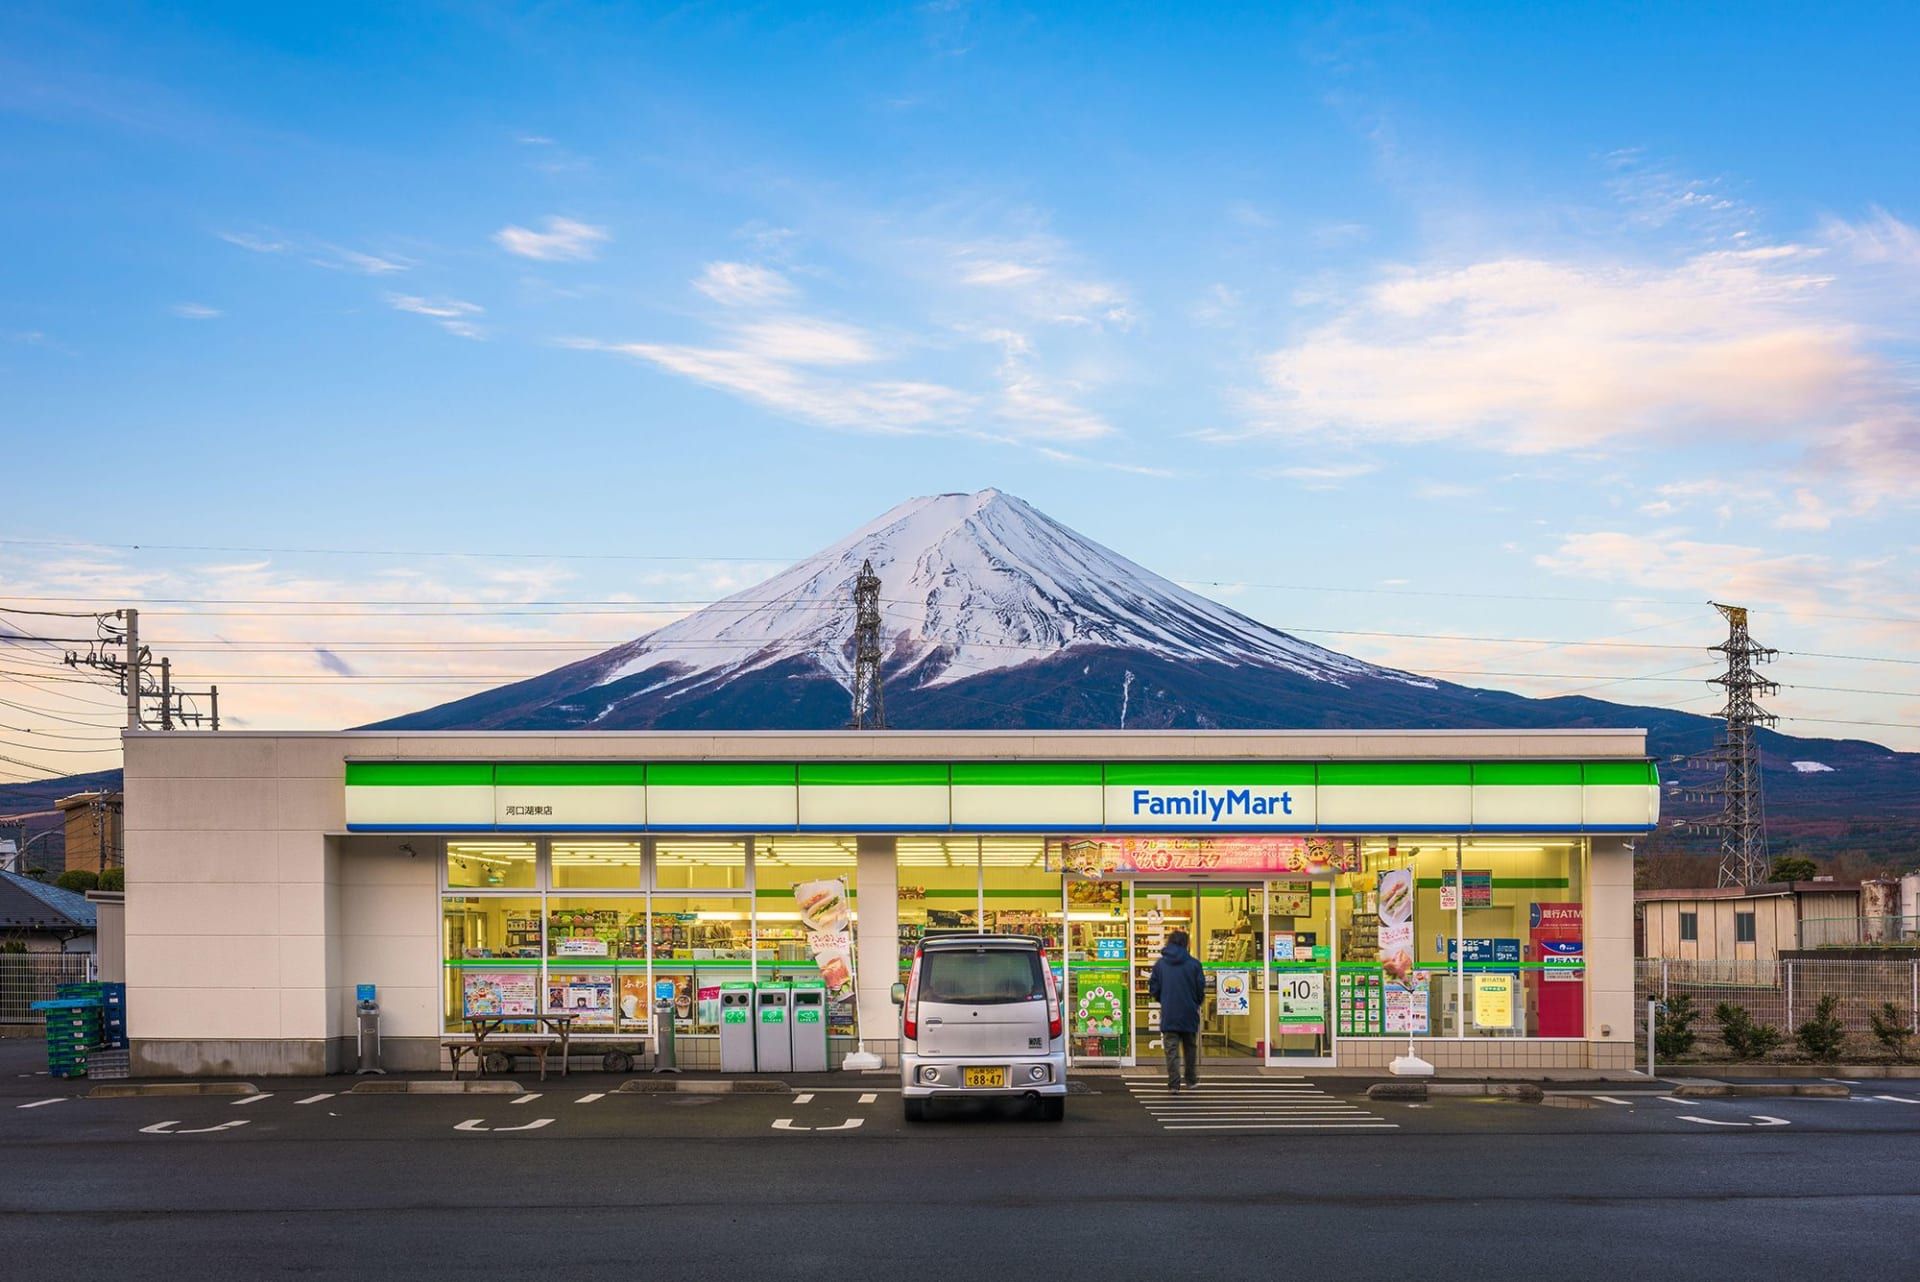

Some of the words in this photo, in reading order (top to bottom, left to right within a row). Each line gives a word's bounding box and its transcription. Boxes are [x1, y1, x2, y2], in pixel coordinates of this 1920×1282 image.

[505, 805, 553, 816] 河口湖東店
[1133, 789, 1292, 822] FamilyMart
[1290, 980, 1310, 999] 10
[973, 1075, 1002, 1085] 88-47
